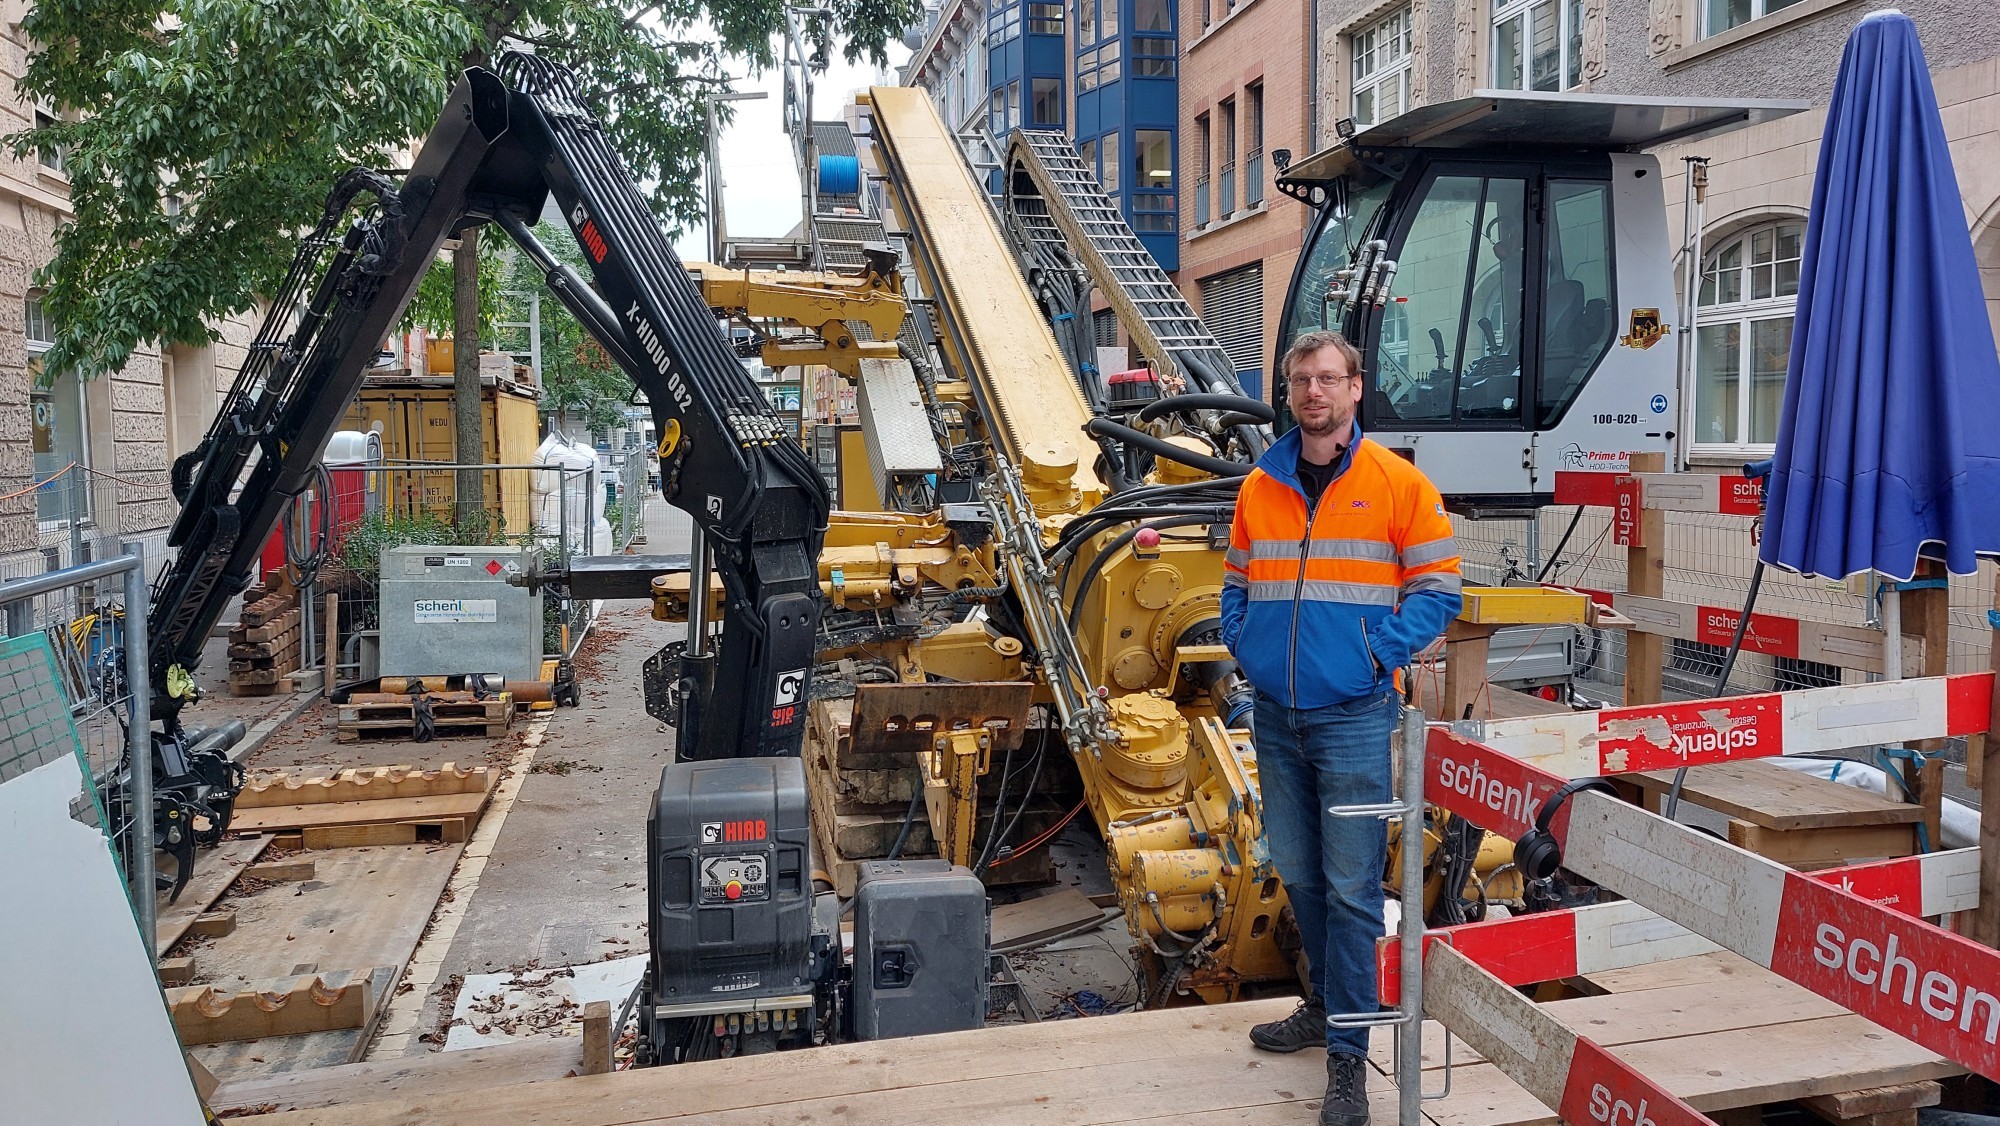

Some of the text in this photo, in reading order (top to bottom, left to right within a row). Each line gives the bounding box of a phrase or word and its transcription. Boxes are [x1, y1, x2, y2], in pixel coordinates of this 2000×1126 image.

[581, 219, 608, 263] HIAB
[625, 300, 693, 414] X-HIDUO 082
[1592, 414, 1638, 424] 100-020
[1588, 451, 1616, 461] Prime
[1589, 462, 1629, 471] HDD-Techn
[426, 487, 440, 496] NET
[1733, 480, 1762, 496] sche
[1619, 493, 1634, 546] sche
[1707, 613, 1755, 637] schek
[1671, 728, 1758, 761] schenk
[1439, 757, 1542, 830] schenk
[725, 820, 767, 842] HIAB
[1813, 922, 2000, 1045] schen
[1589, 1083, 1657, 1126] sch
